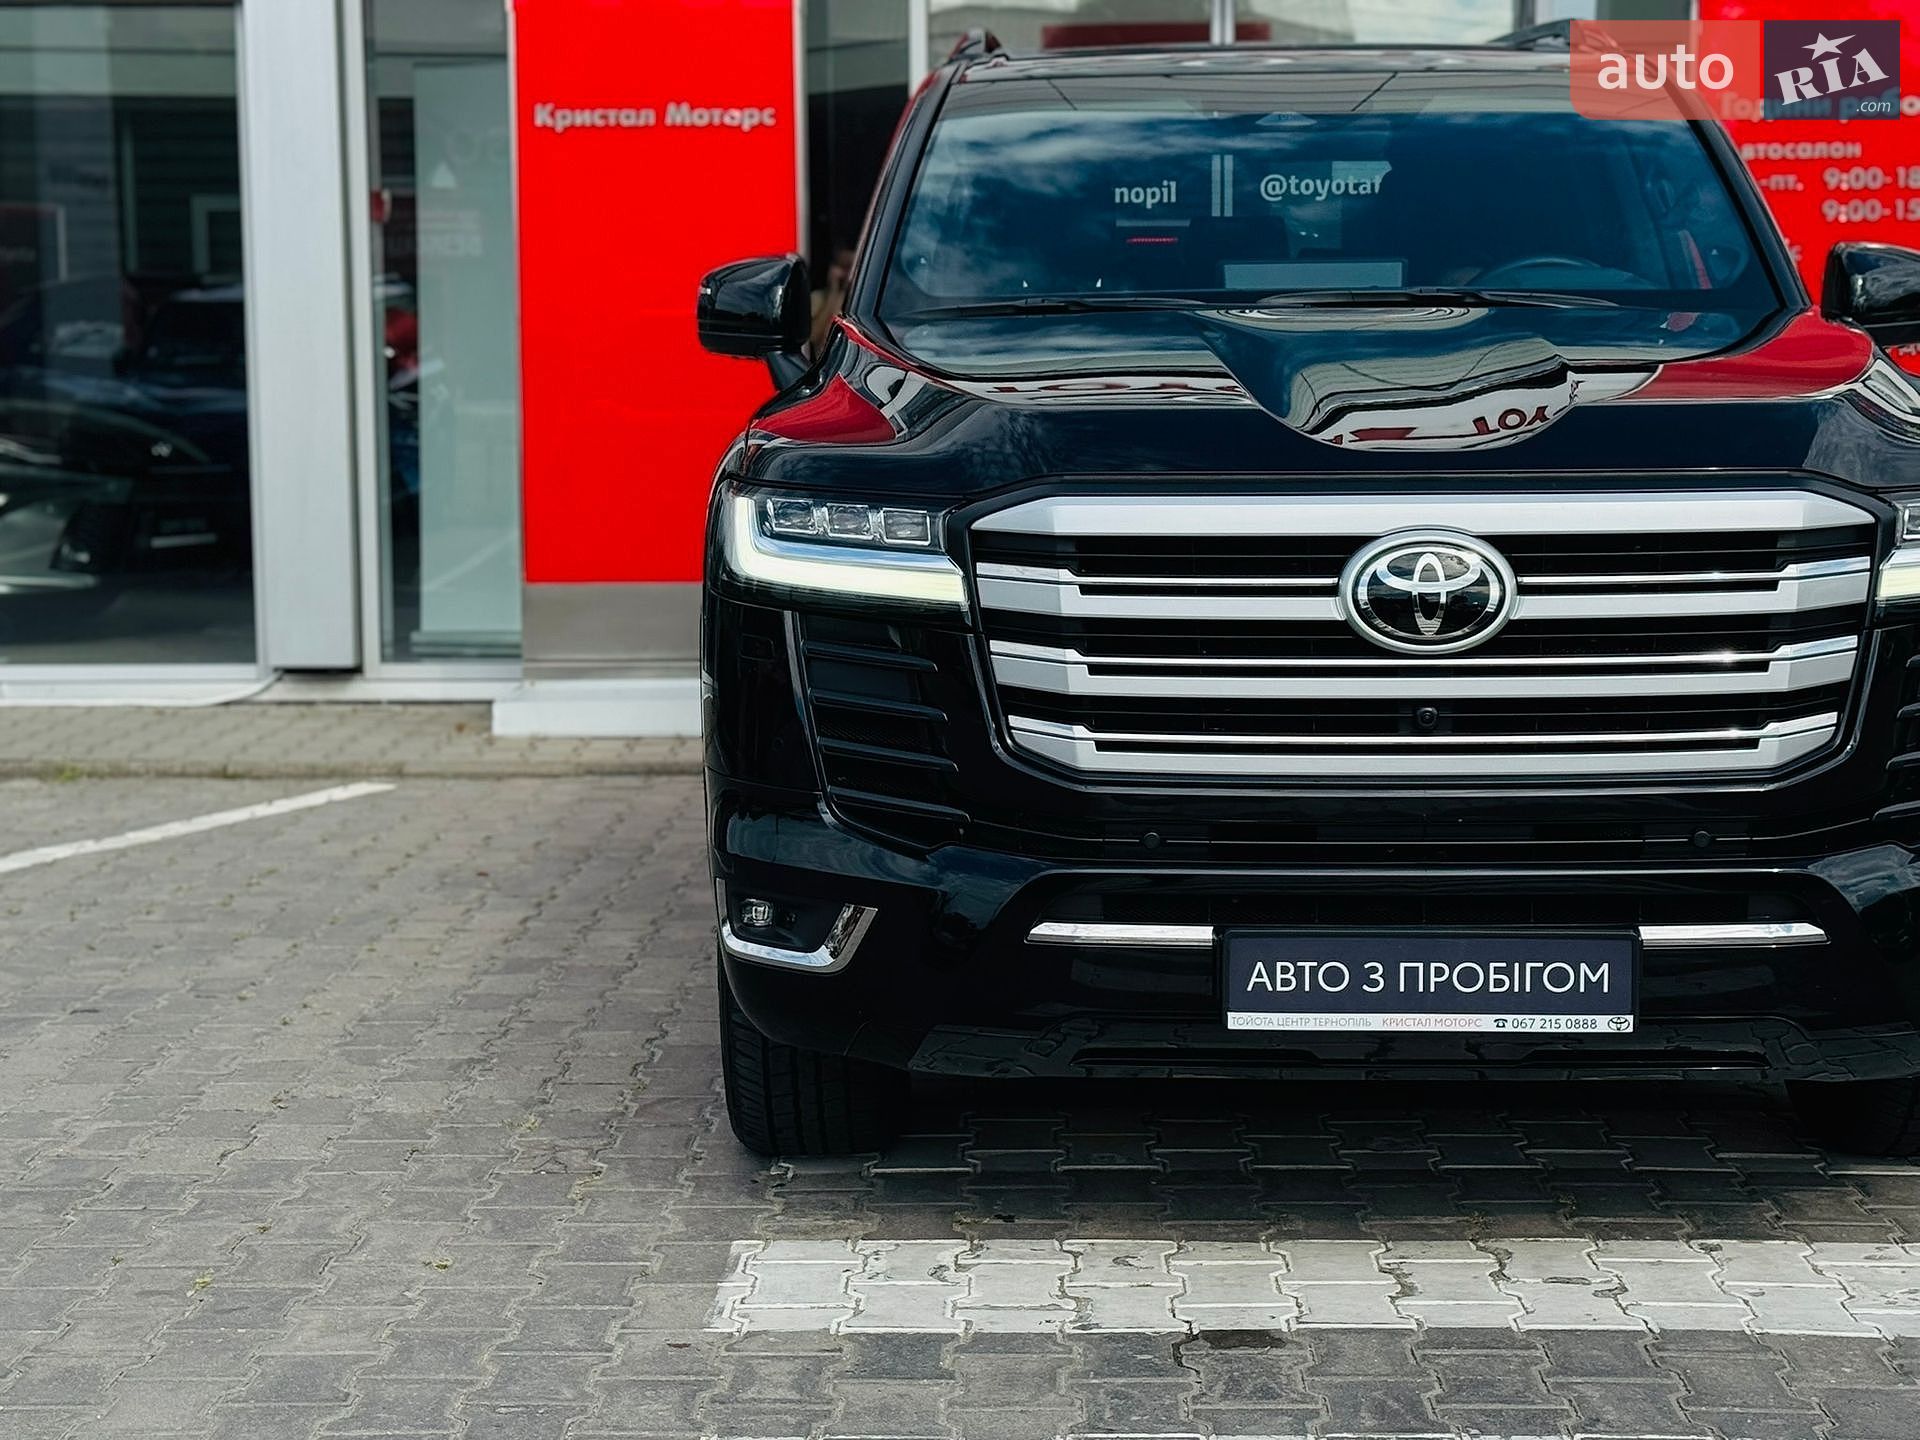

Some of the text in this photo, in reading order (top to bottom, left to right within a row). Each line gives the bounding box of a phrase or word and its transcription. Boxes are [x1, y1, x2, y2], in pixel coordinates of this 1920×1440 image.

[534, 103, 656, 133] Кристал
[1114, 180, 1177, 209] nopil
[1246, 961, 1609, 993] АВТО З ПРОБІГОМ
[1231, 1015, 1598, 1031] ТОЙОТА ЦЕНТР ТЕРНОПІЛЬ КРИСТАЛ МОТОРС 067 215 0888
